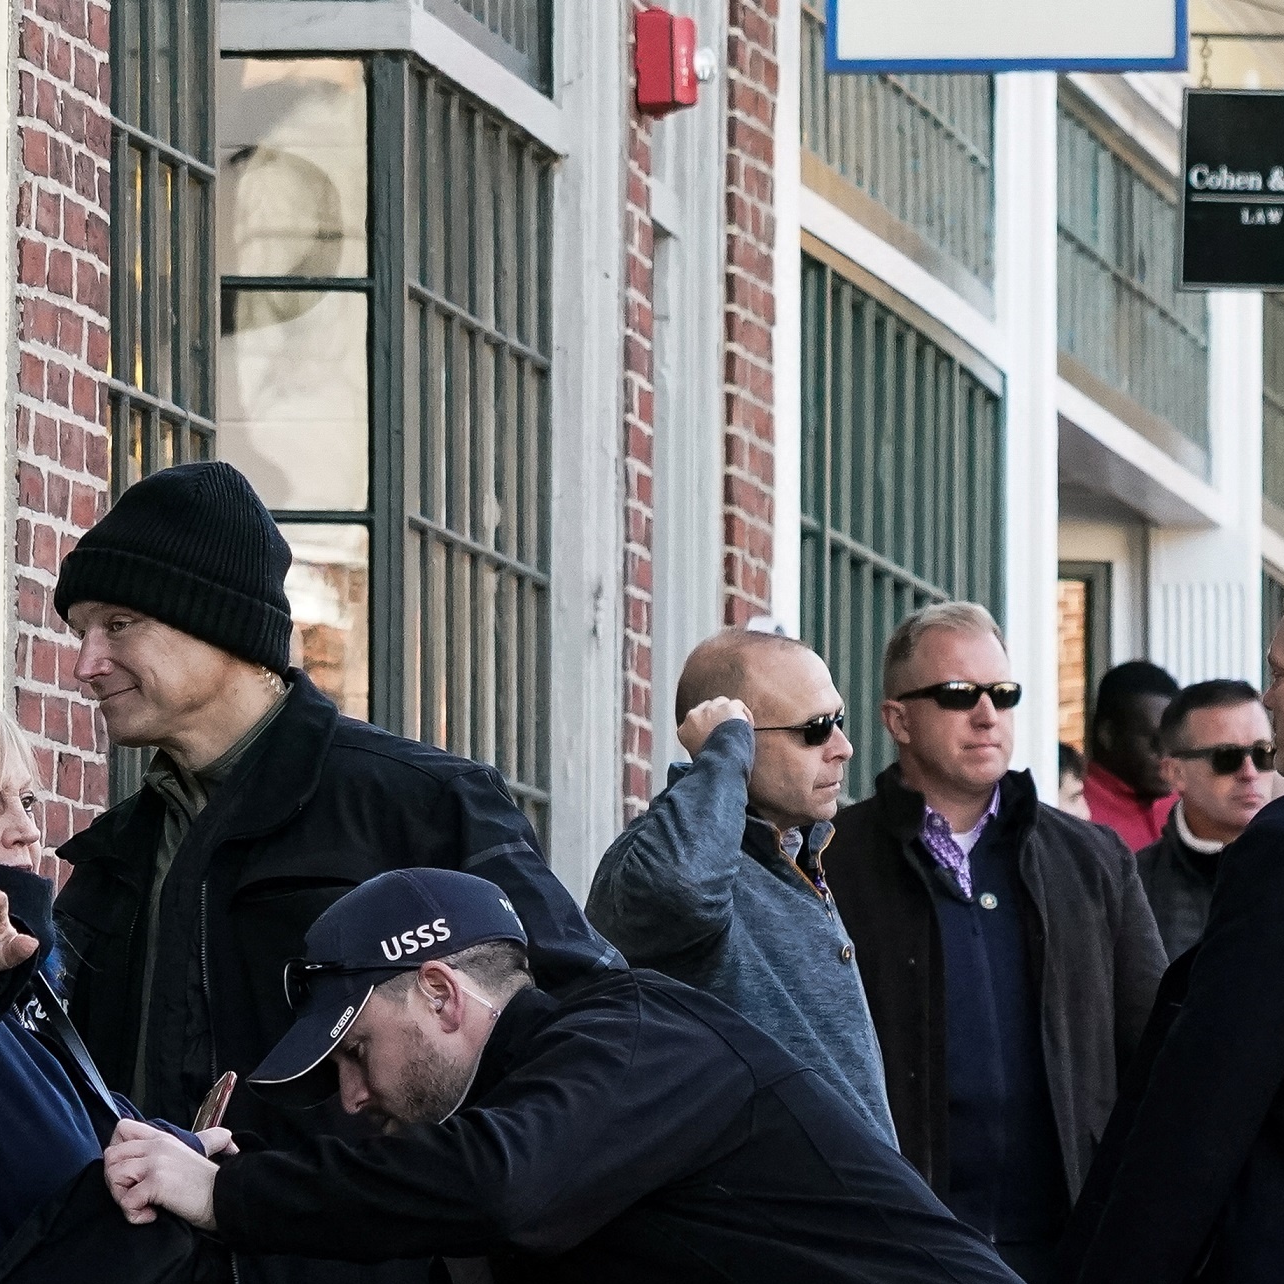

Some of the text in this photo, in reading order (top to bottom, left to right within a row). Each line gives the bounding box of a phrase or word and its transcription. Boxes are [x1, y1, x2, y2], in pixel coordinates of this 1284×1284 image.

[1189, 163, 1263, 191] Cohen
[1240, 207, 1283, 226] LAW
[380, 918, 451, 962] USSS
[329, 1005, 355, 1039] OGIO
